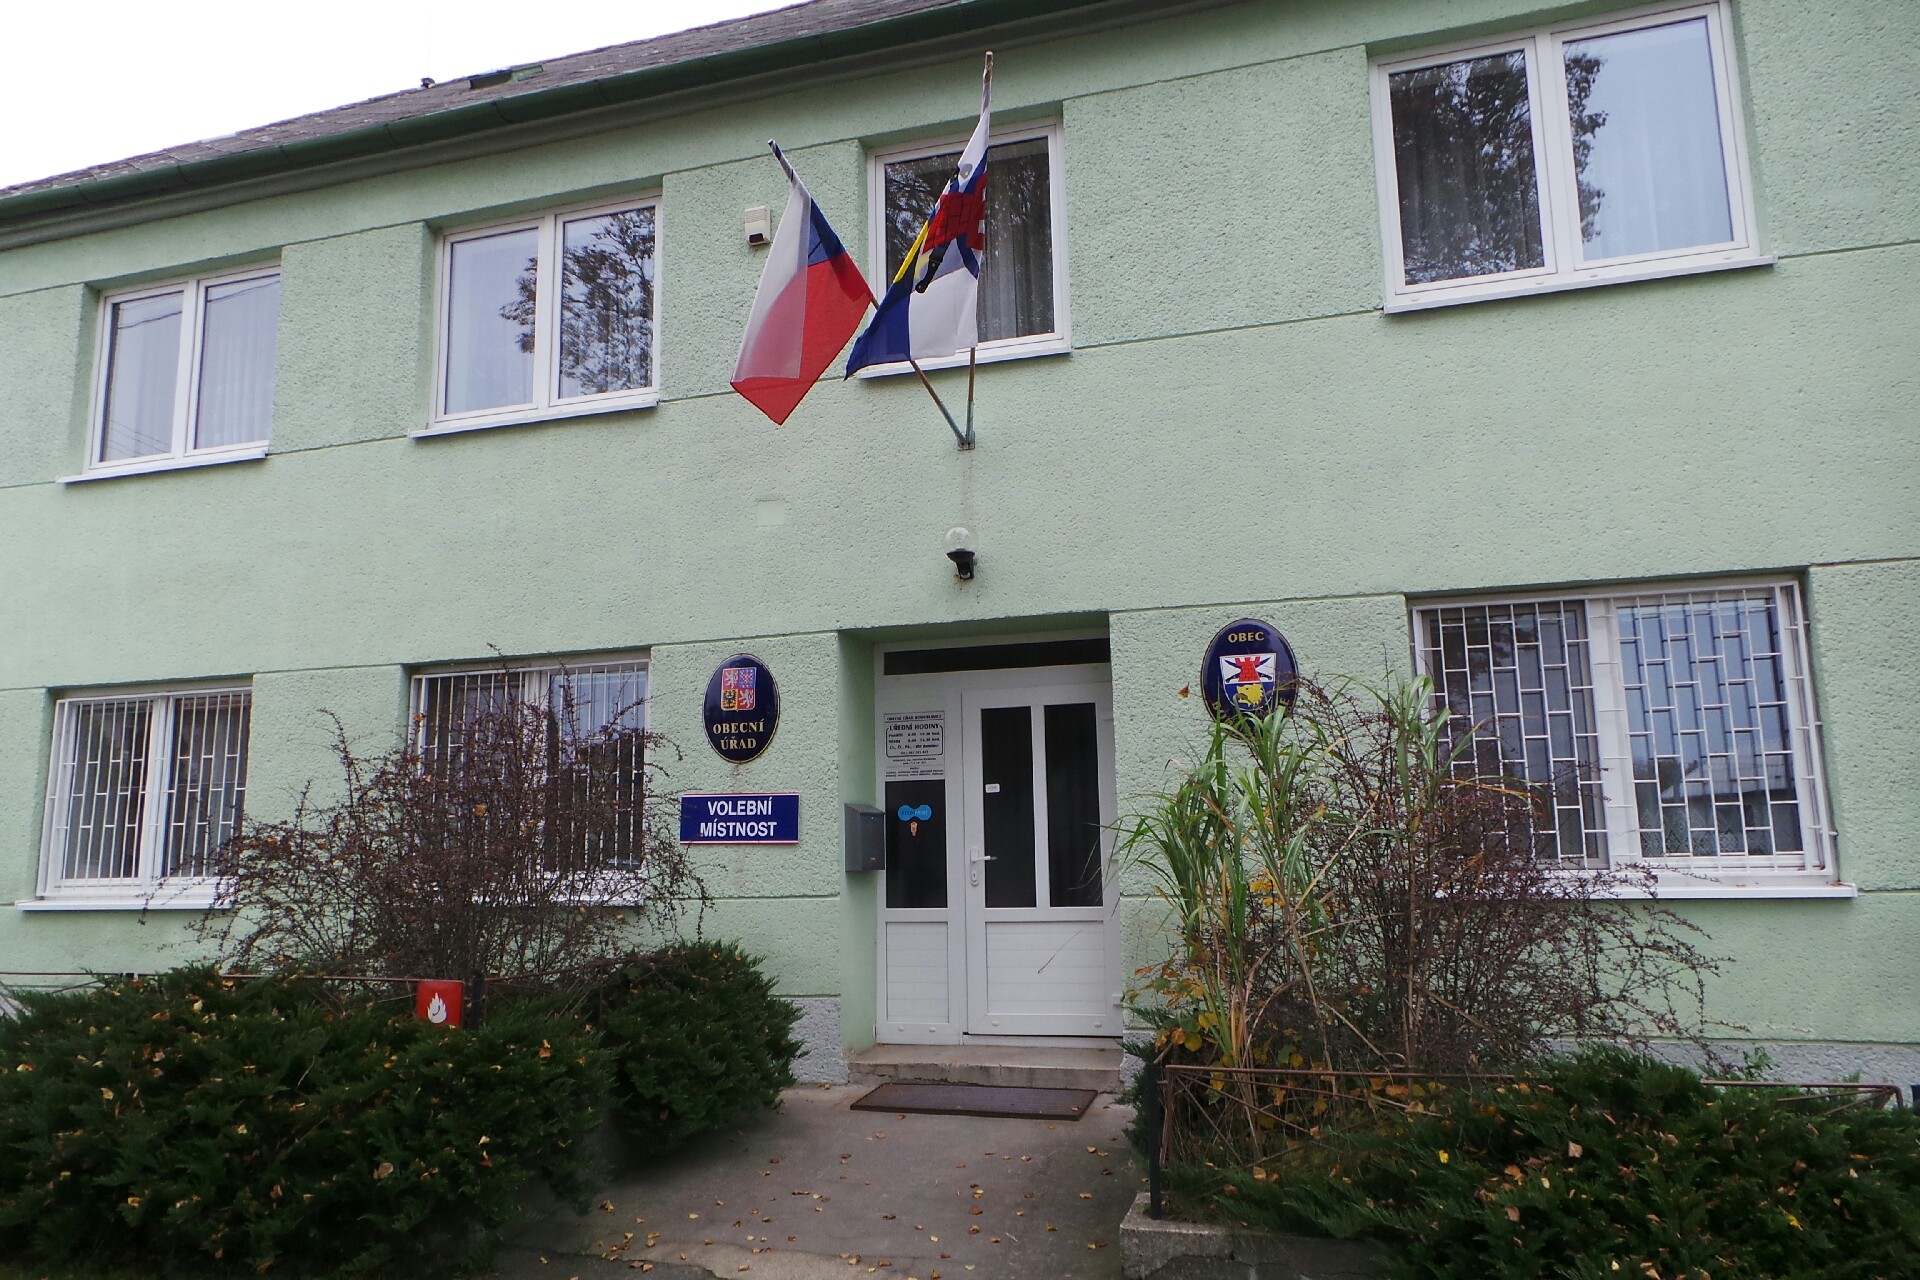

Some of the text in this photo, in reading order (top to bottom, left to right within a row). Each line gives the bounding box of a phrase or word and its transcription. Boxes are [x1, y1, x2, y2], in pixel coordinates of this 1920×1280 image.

[1228, 632, 1264, 642] OBEC
[714, 719, 764, 735] OBECNÍ
[889, 723, 912, 731] ÚŘEDNÍ
[721, 737, 756, 750] ÚŘAD
[708, 797, 773, 816] VOLEBNÍ
[700, 819, 777, 837] MÍSTNOST
